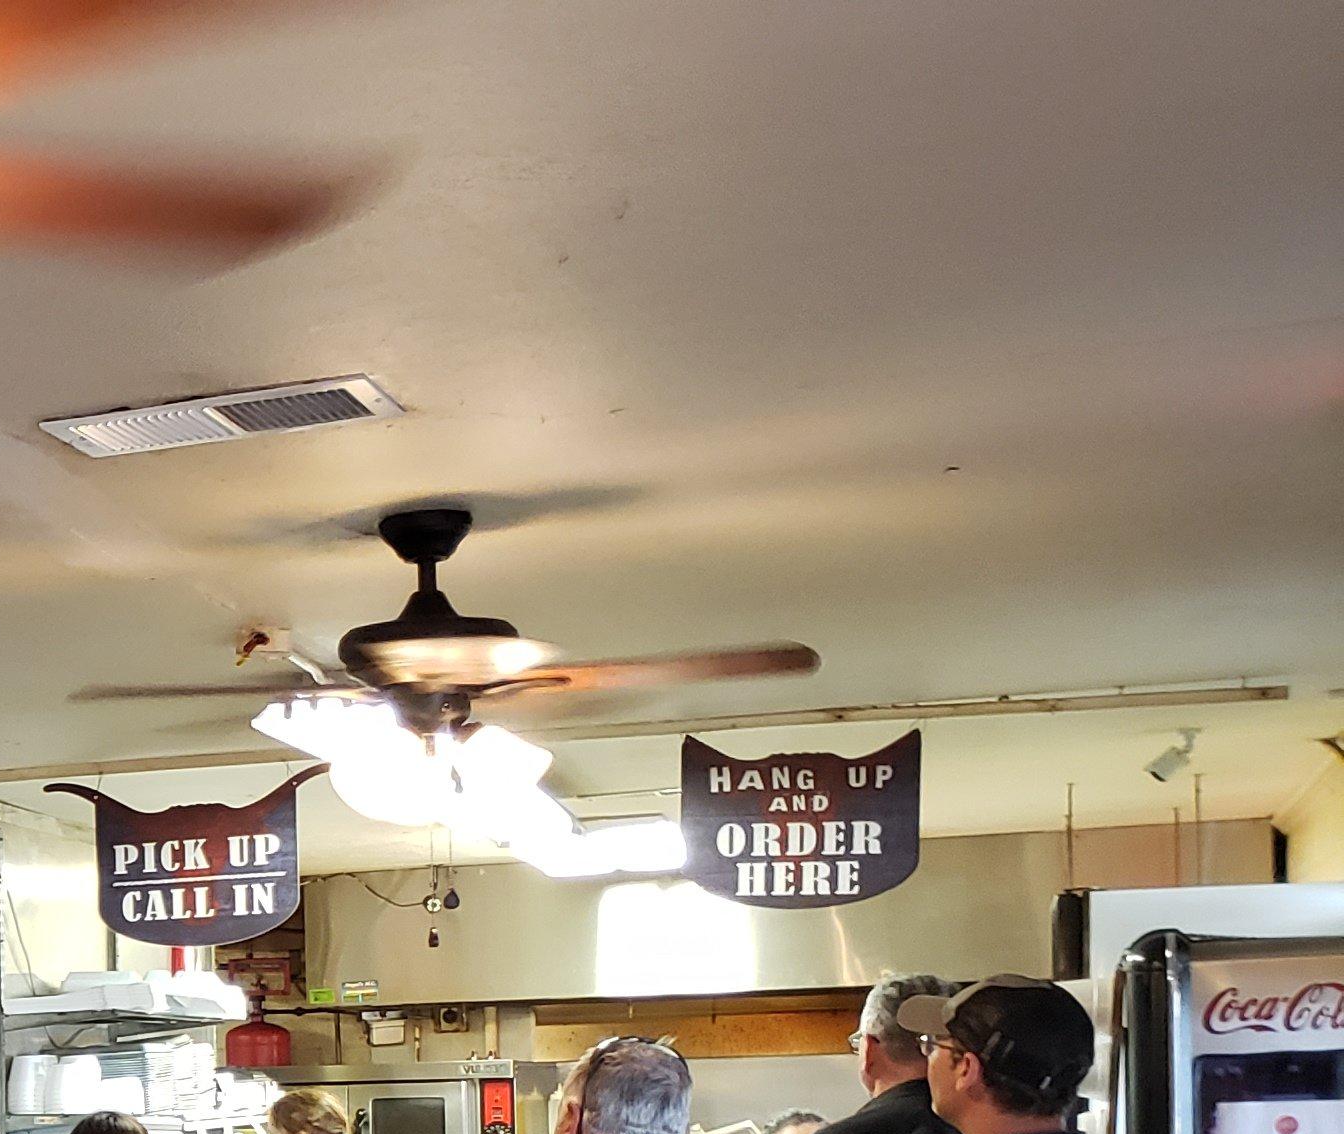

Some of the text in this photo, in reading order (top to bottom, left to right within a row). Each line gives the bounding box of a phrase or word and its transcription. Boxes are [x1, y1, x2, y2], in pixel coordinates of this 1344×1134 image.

[709, 764, 893, 793] HANG UP
[768, 794, 830, 813] AND
[113, 833, 281, 875] PICK UP
[716, 820, 882, 858] ORDER
[735, 860, 861, 897] HERE
[122, 882, 275, 923] CALL IN
[1203, 981, 1344, 1035] Coca-Col
